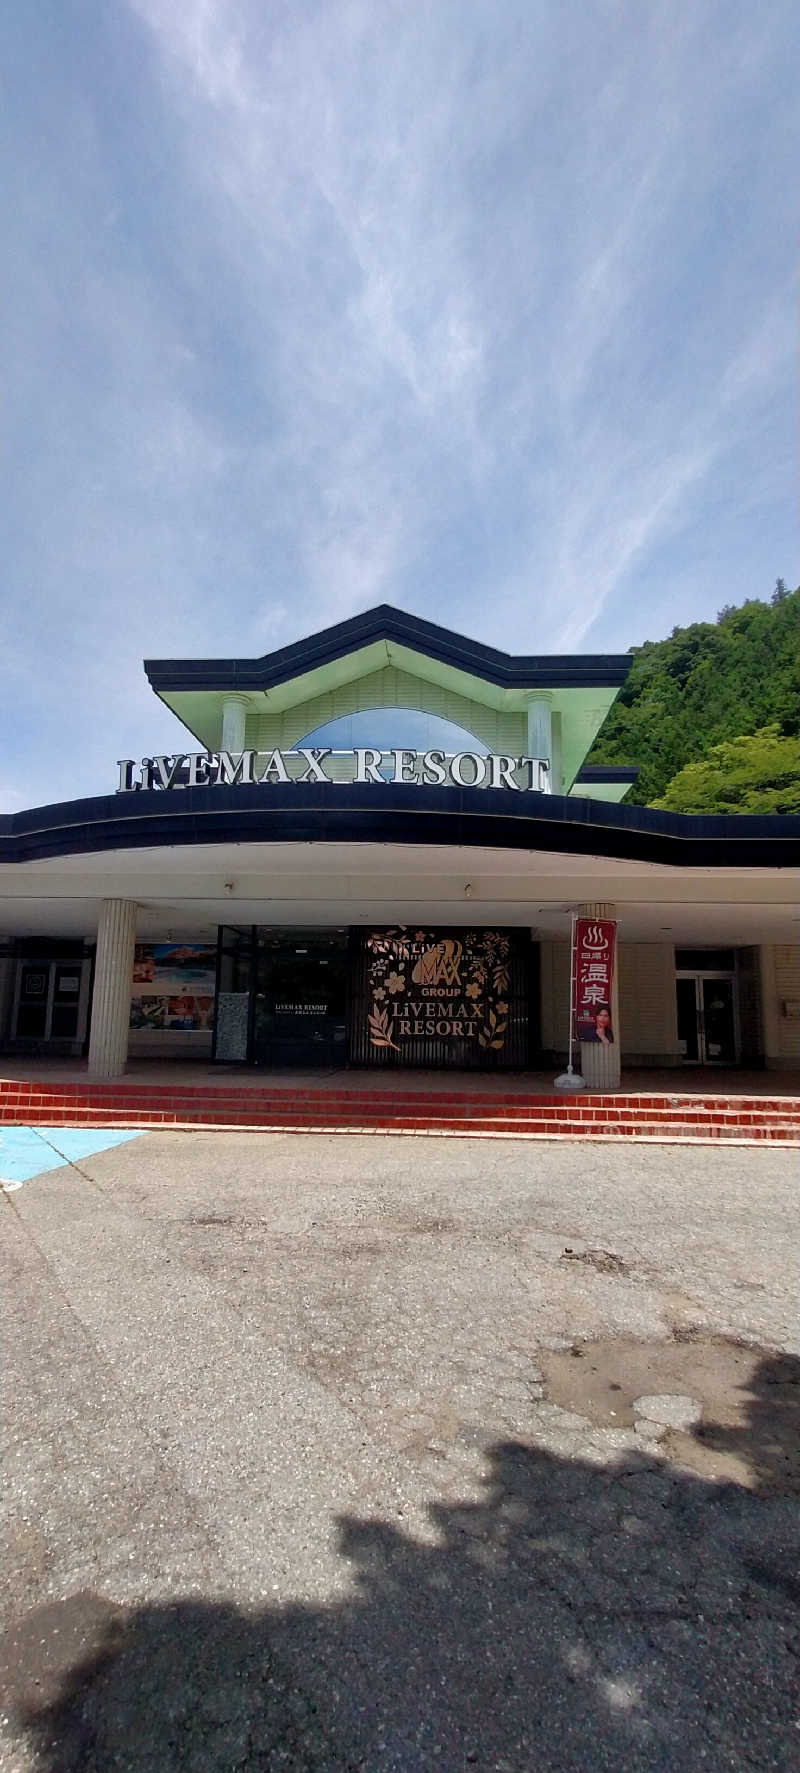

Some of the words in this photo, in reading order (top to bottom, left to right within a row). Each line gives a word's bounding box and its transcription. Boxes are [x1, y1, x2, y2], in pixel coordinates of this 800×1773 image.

[117, 748, 333, 793] LiVEMAX
[353, 748, 551, 793] RESORT
[421, 958, 462, 985] MAX
[421, 987, 461, 997] GROUP
[580, 963, 609, 1006] 温泉
[392, 1002, 485, 1018] LiVEMAX
[399, 1020, 478, 1037] RESORT
